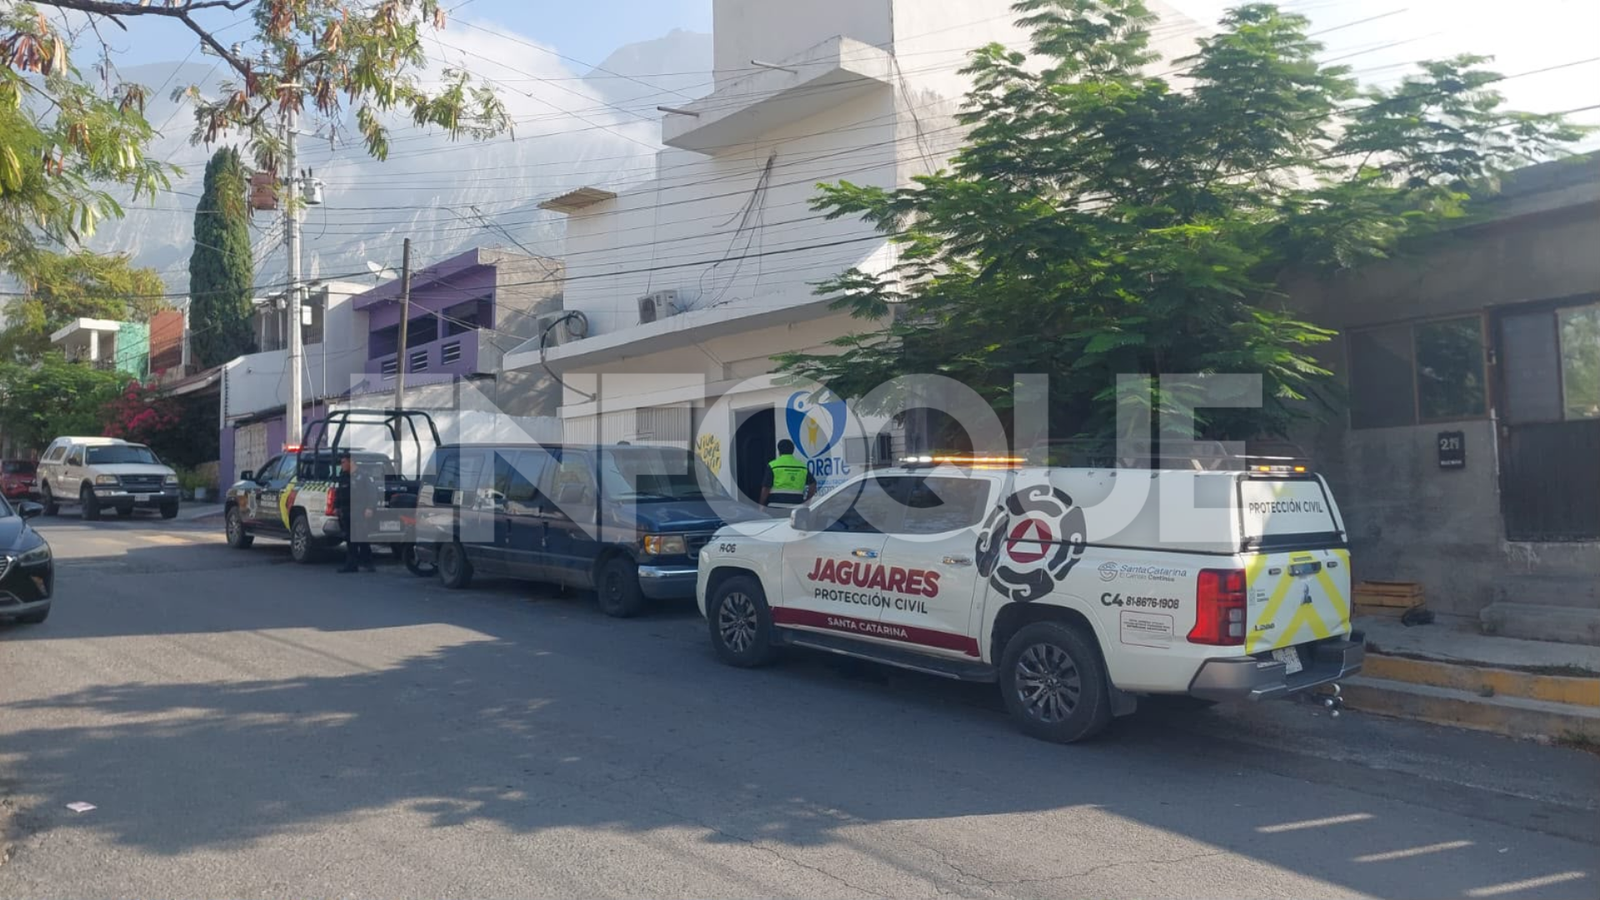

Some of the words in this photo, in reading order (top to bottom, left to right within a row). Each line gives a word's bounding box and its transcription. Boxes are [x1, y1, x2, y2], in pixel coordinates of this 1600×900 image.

[1249, 498, 1302, 514] PROTECCIÓN
[1303, 500, 1324, 513] CIVIL
[807, 557, 941, 598] JAGUARES
[814, 588, 891, 609] PROTECCIÓN
[894, 598, 928, 614] CIVIL
[1100, 592, 1124, 607] C4
[827, 617, 858, 629] SANTA
[859, 622, 908, 639] CATARINA
